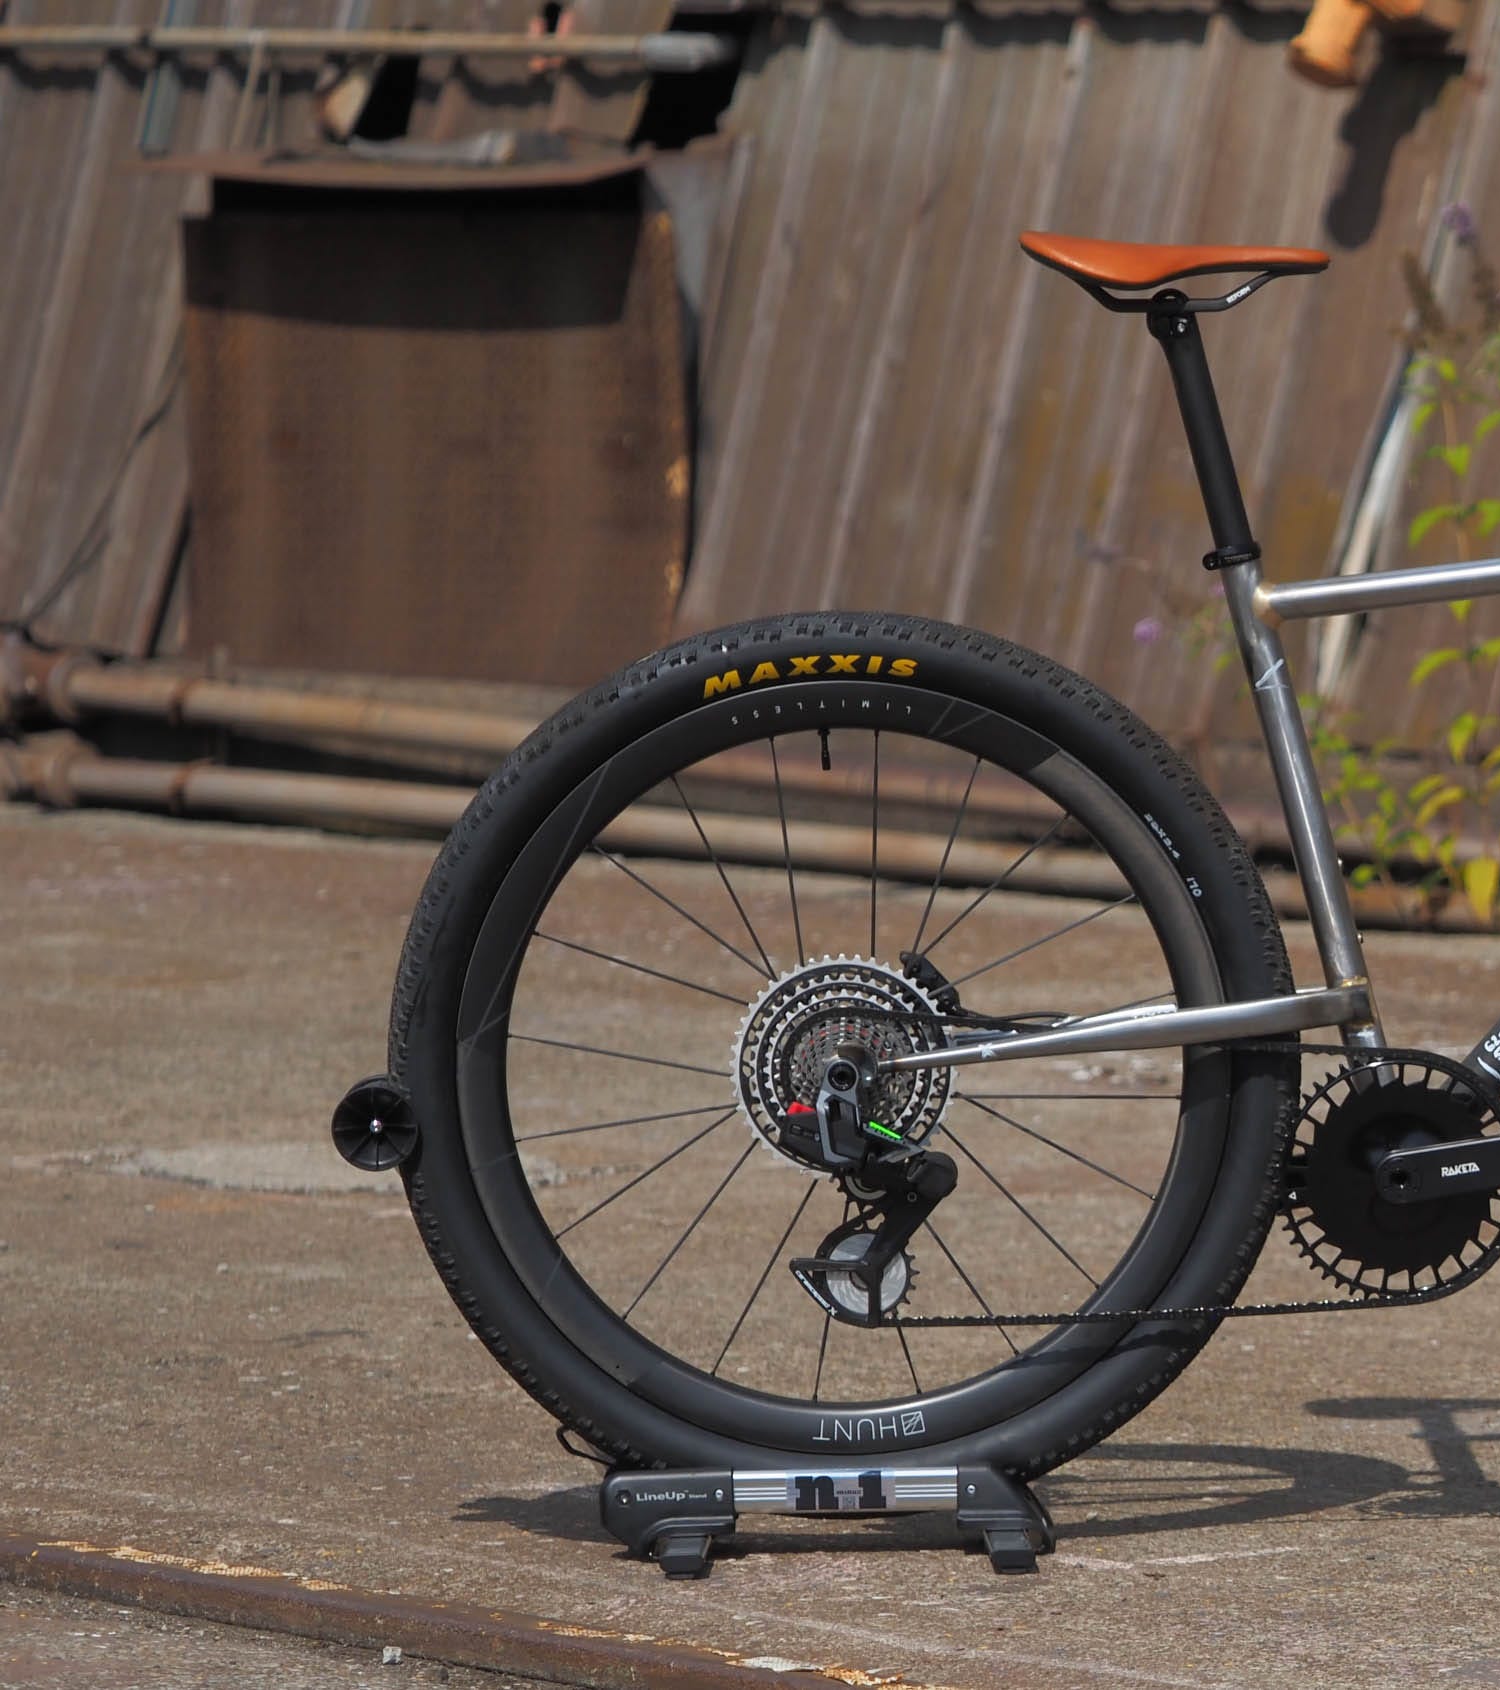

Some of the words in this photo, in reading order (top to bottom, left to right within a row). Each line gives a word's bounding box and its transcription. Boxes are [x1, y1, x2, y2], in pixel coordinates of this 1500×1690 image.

[703, 654, 919, 699] MAXXIS
[731, 699, 912, 725] LIMITLESS
[1441, 1161, 1480, 1178] RAKETA
[812, 1415, 898, 1441] HUNT
